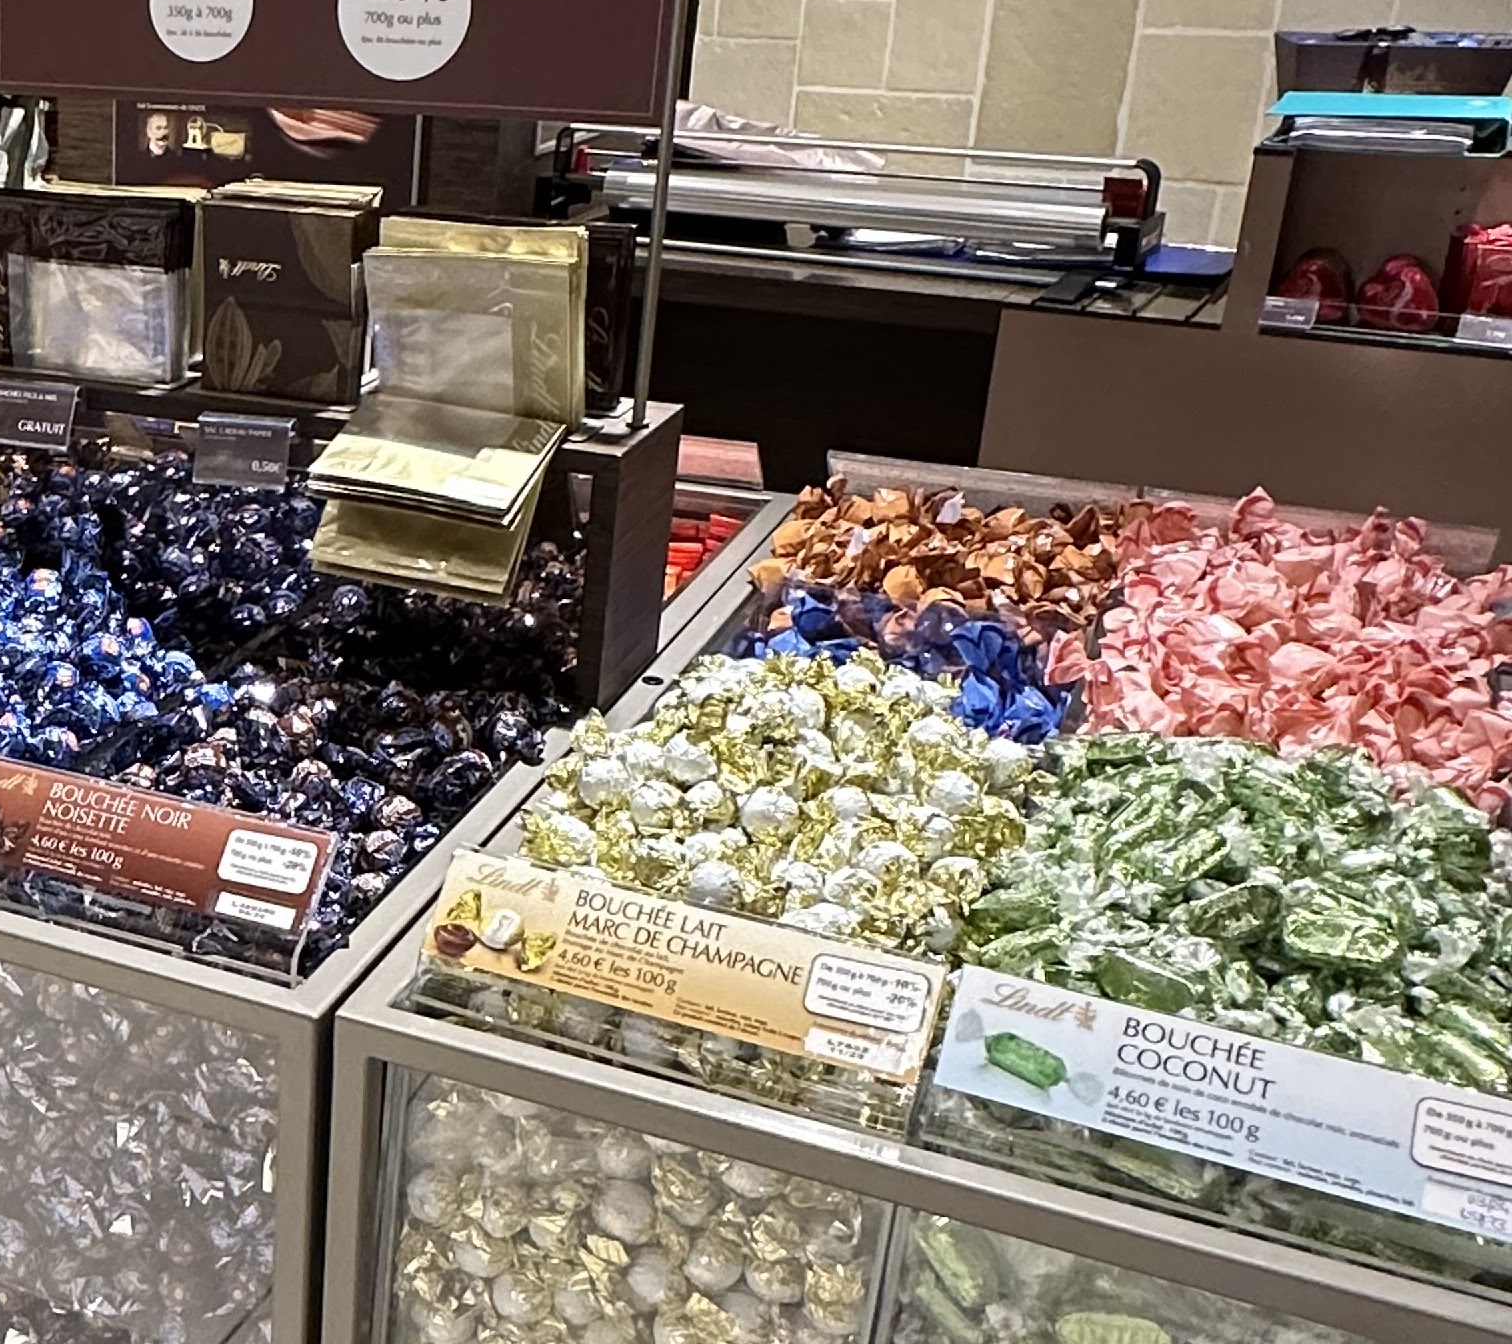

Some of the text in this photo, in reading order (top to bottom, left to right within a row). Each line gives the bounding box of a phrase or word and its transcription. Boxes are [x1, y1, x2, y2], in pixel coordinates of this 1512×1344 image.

[196, 5, 202, 17] à
[206, 6, 233, 23] 700g
[364, 11, 442, 29] 700g ou plus
[230, 259, 282, 281] Lindt
[18, 419, 66, 436] GRATUIT
[41, 799, 130, 835] NOISETTE
[48, 782, 192, 831] BOUCHÉE NOIR
[31, 834, 58, 849] 4,60
[58, 840, 67, 852] €
[70, 840, 87, 857] les
[467, 862, 542, 896] Lindt
[575, 889, 727, 942] BOUCHÉE LAIT
[558, 949, 592, 968] 4,60
[594, 957, 606, 971] €
[609, 960, 631, 977] les
[568, 910, 630, 941] MARC
[634, 926, 662, 949] DE
[667, 935, 804, 986] CHAMPAGNE
[982, 982, 1075, 1022] Lindt
[1122, 1016, 1266, 1071] BOUCHÉE
[1117, 1043, 1278, 1101] COCONUT
[1107, 1086, 1150, 1108] 4,60
[1154, 1096, 1168, 1113] €
[1173, 1098, 1201, 1122] les
[1426, 1106, 1443, 1119] De
[1470, 1136, 1495, 1150] plus
